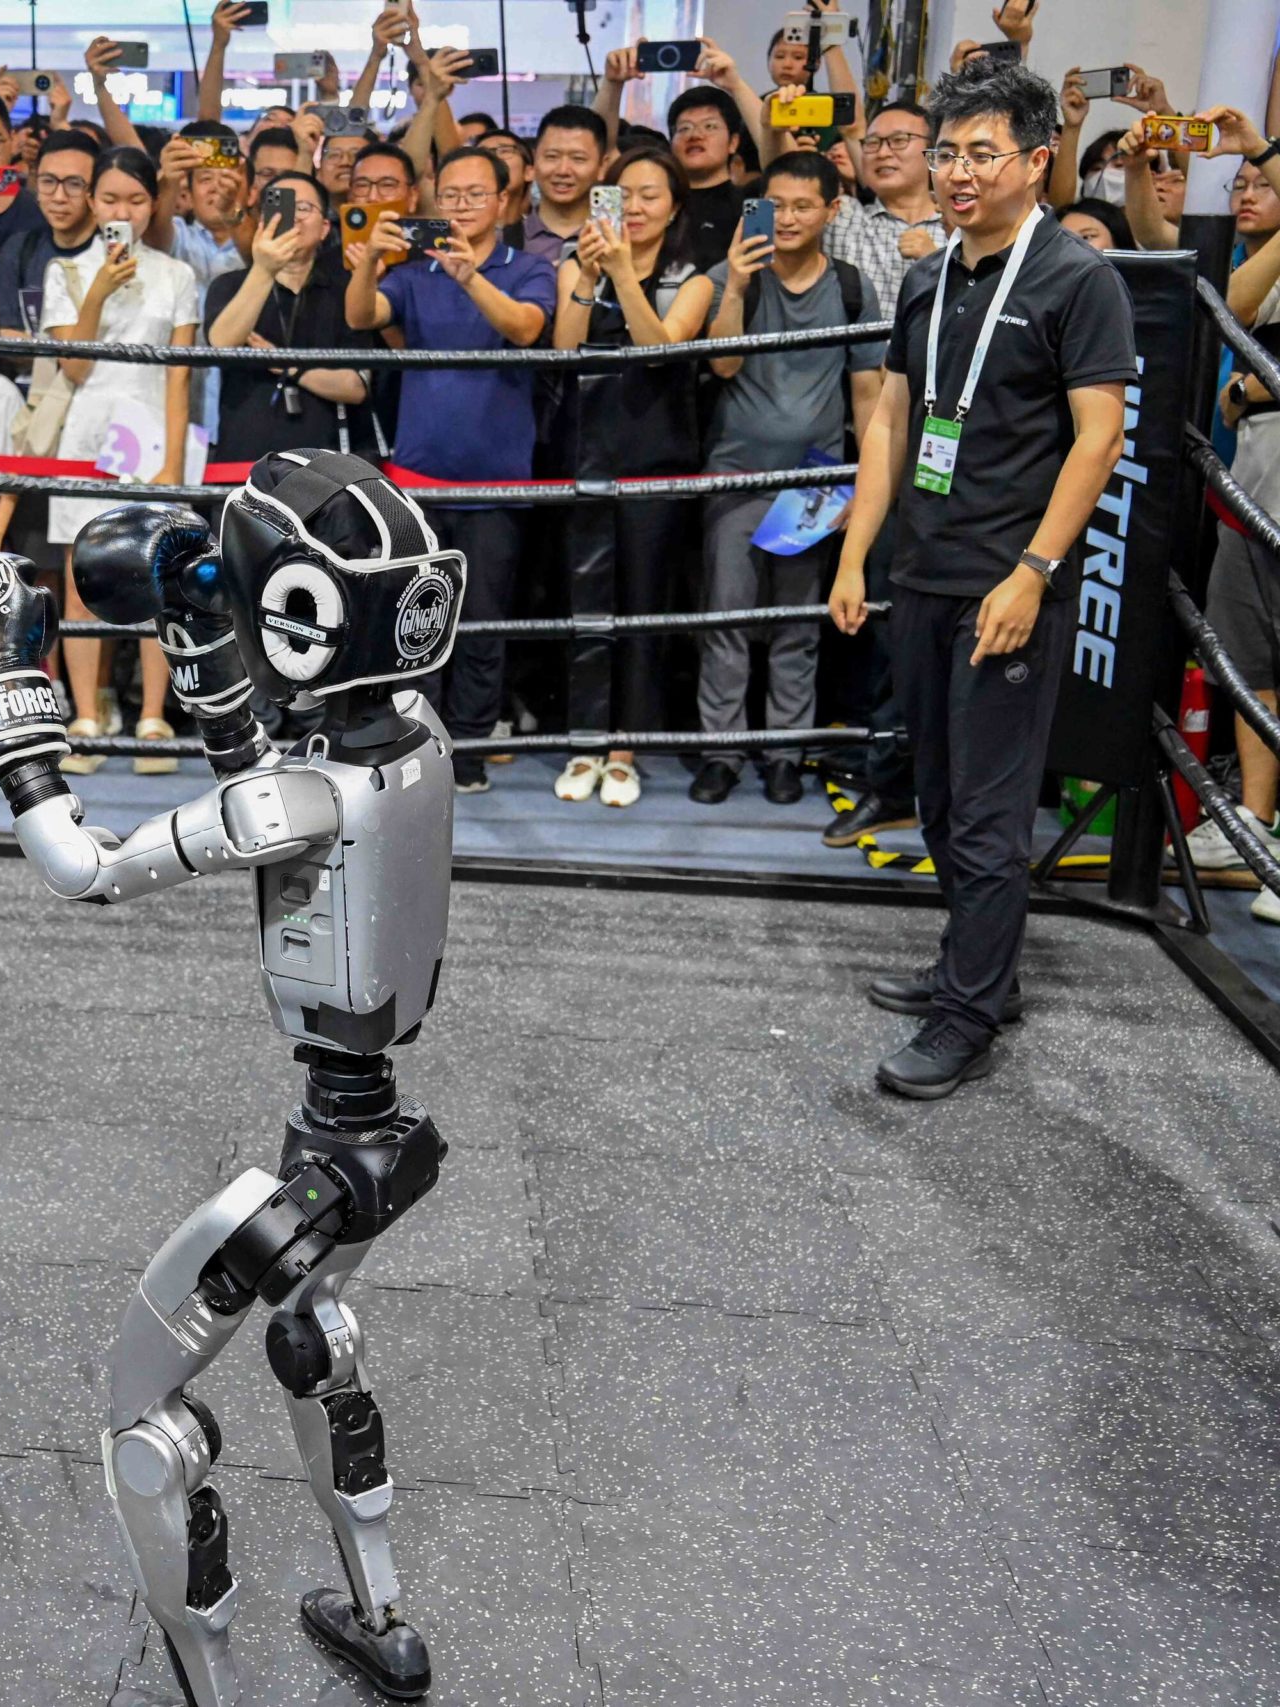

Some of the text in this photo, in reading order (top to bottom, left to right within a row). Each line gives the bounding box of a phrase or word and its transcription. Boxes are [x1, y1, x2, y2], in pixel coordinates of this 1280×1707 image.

[396, 573, 420, 609] GINGPAI
[268, 617, 322, 639] VERSION 2.0
[400, 601, 448, 636] GINGPAI
[396, 653, 431, 670] GING
